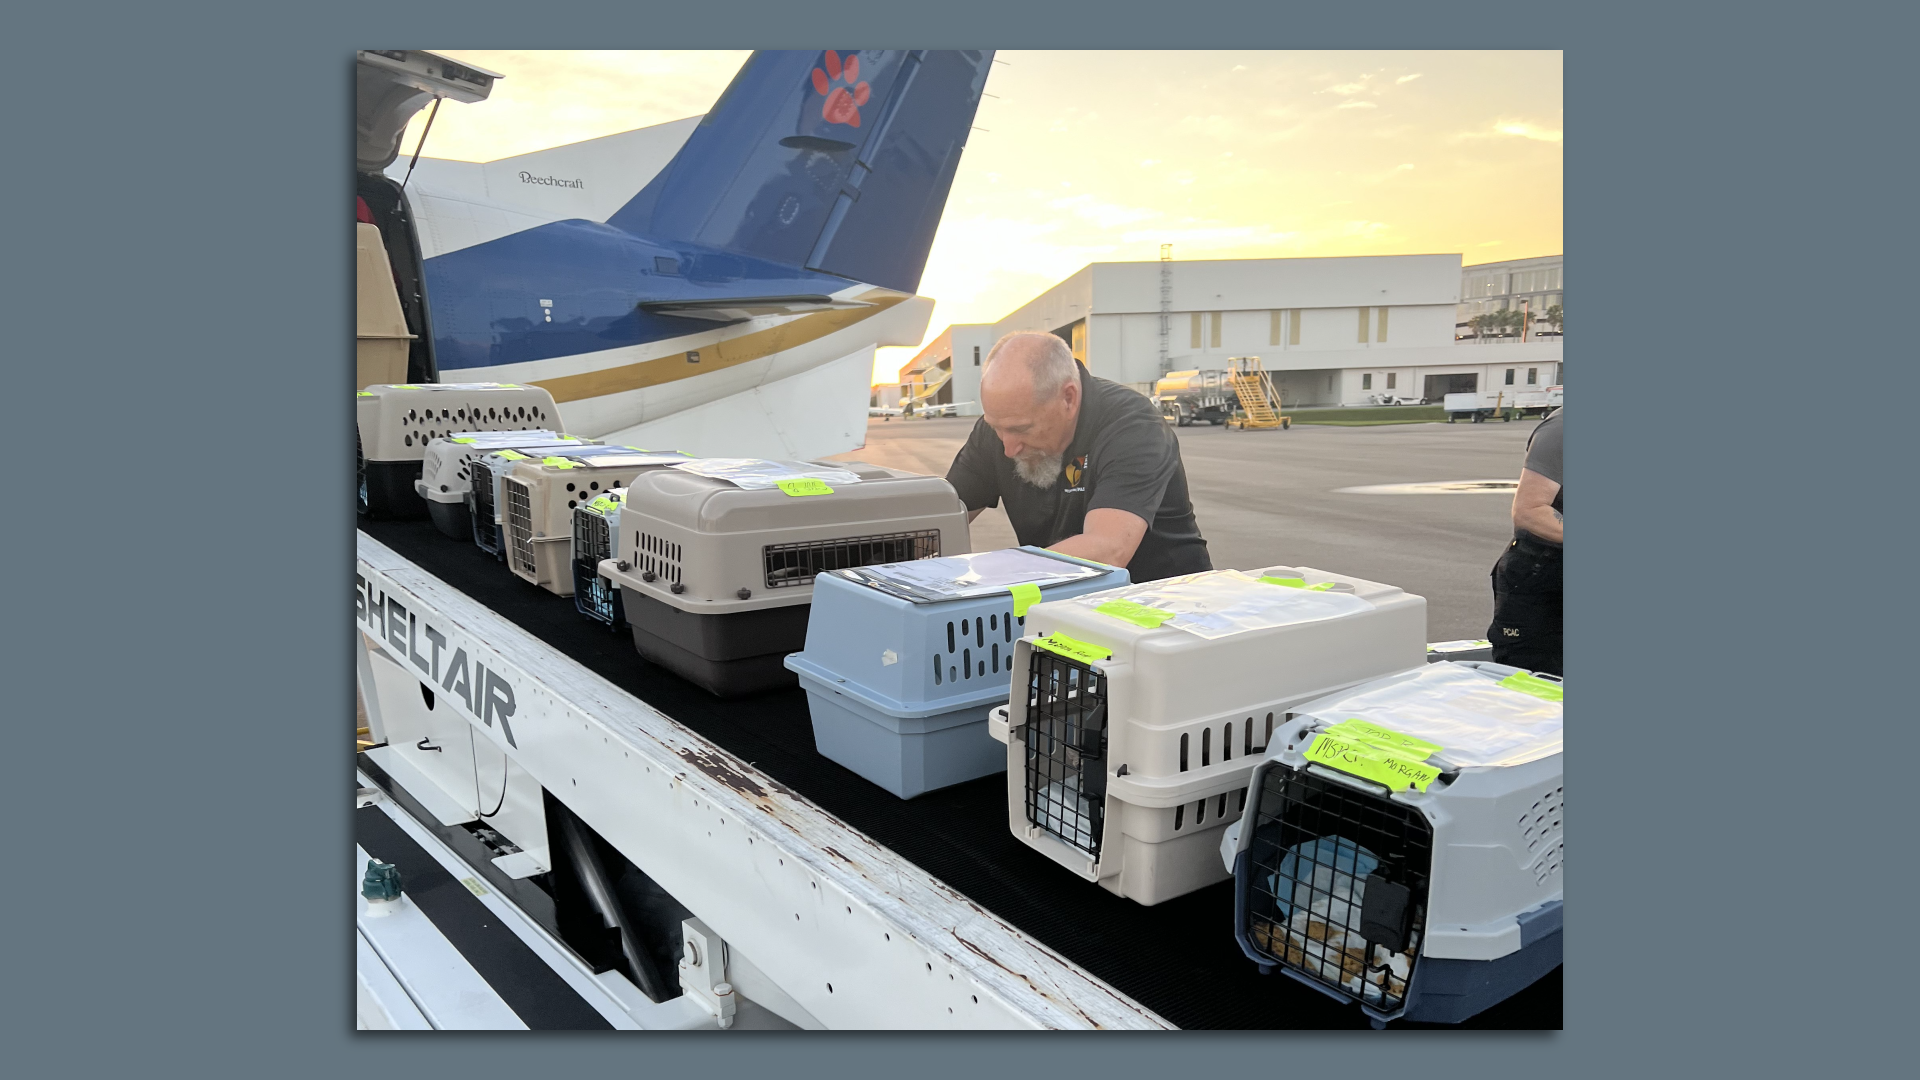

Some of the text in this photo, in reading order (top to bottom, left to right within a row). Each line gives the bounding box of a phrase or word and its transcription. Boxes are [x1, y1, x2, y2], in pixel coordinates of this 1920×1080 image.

[518, 171, 584, 189] Beechcraft
[357, 573, 518, 750] SHELTAIR
[1384, 758, 1430, 782] MORGAN
